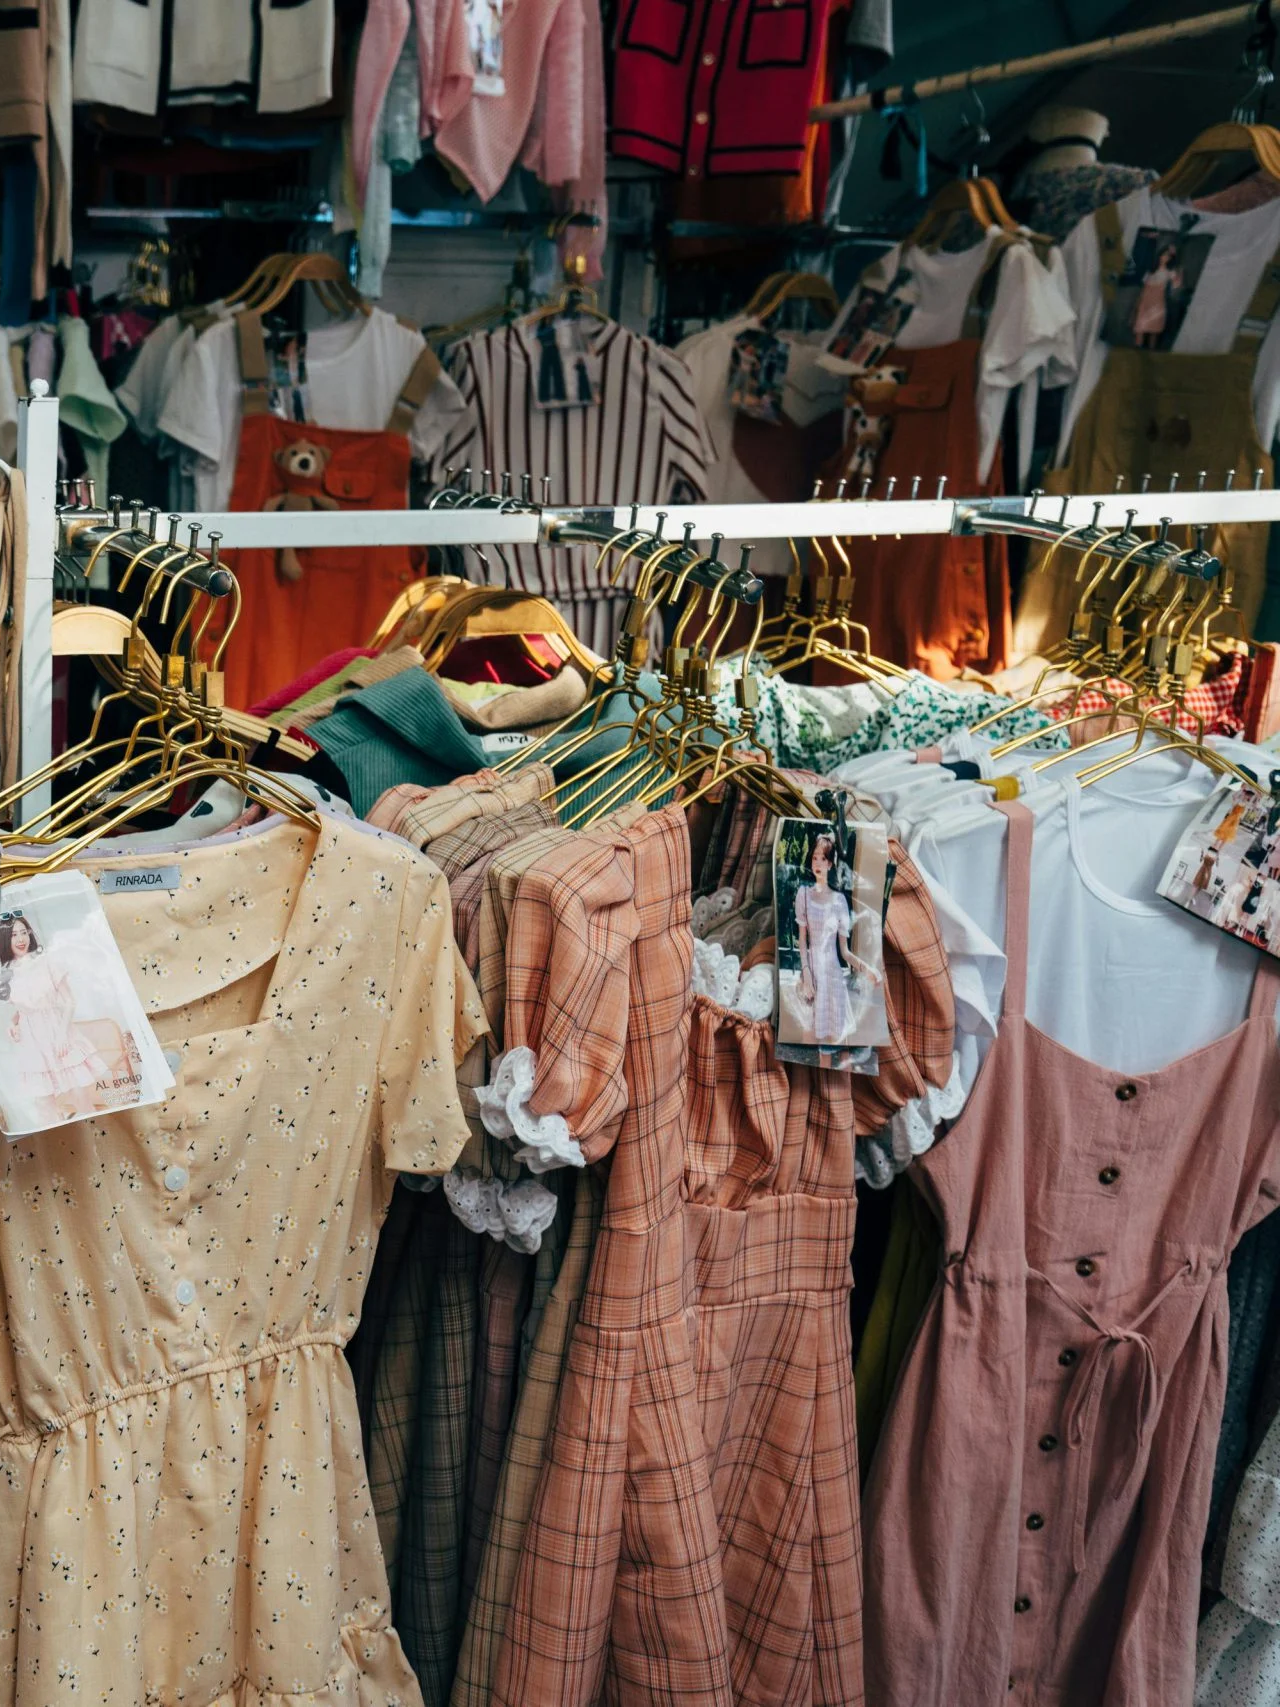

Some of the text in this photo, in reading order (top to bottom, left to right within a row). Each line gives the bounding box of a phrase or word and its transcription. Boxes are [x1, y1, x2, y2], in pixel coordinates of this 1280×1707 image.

[115, 874, 163, 886] RINRADA
[94, 1073, 142, 1091] AL group
